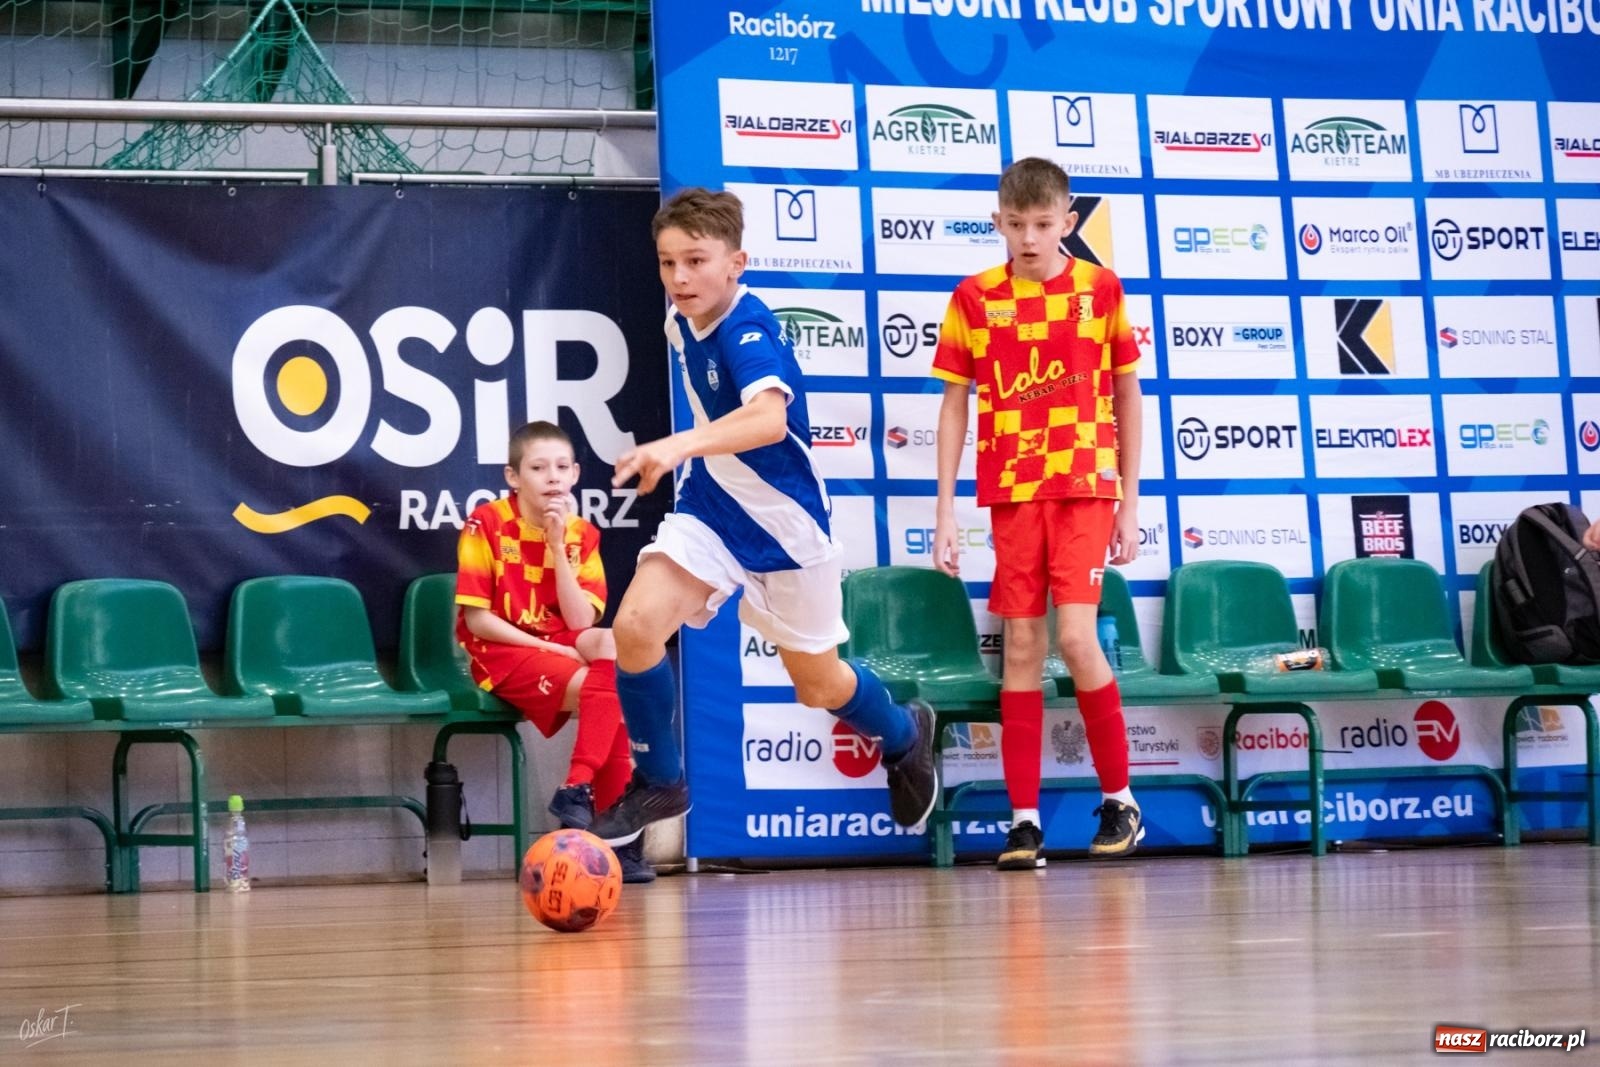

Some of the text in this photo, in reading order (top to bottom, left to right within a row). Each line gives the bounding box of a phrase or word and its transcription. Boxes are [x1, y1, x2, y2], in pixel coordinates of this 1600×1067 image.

[729, 11, 837, 39] Racibórz
[769, 47, 798, 65] 1217
[1453, 169, 1532, 179] UBEZPIECZENIA
[881, 218, 935, 240] BOXY
[1329, 226, 1380, 243] Marco
[1466, 226, 1544, 250] SPORT
[764, 257, 853, 269] UBEZPIECZENIA
[1172, 326, 1224, 347] BOXY
[1462, 329, 1554, 345] SONING STAL
[994, 346, 1066, 399] Lolo
[1214, 425, 1297, 449] SPORT
[1316, 428, 1431, 448] ELEKTROLEX
[1207, 529, 1307, 546] SONING STAL
[1361, 519, 1404, 536] BEEF
[1363, 537, 1405, 552] BROS
[1234, 727, 1310, 750] Racibór
[1341, 717, 1408, 748] radio
[746, 731, 822, 761] radio
[1132, 739, 1179, 754] Turystyki
